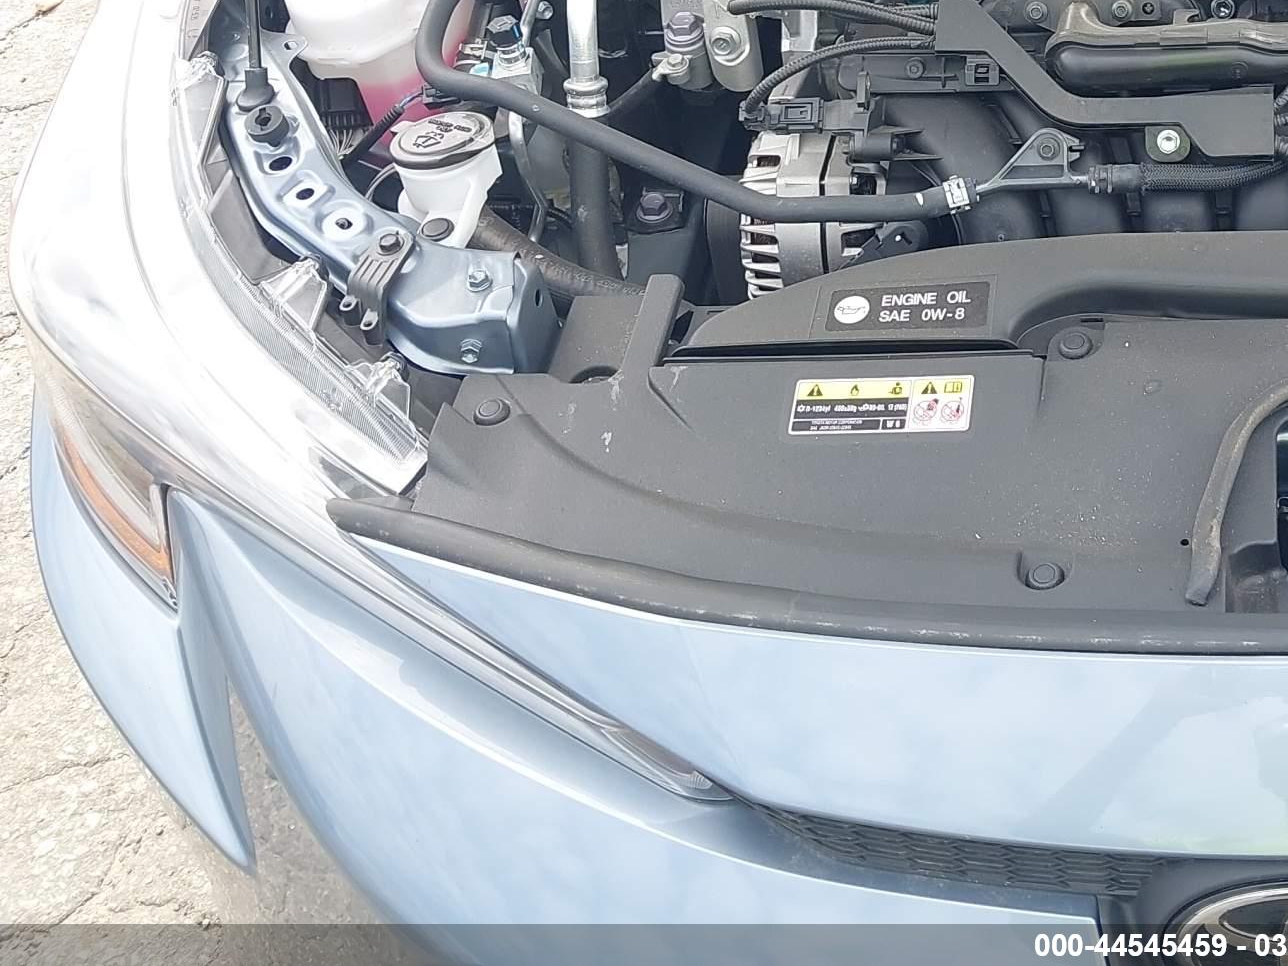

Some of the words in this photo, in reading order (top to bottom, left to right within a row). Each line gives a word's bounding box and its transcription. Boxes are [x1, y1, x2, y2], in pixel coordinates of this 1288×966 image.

[881, 292, 937, 307] ENGINE
[946, 290, 971, 304] OIL
[878, 309, 910, 322] SAE
[921, 307, 965, 321] 0W-8
